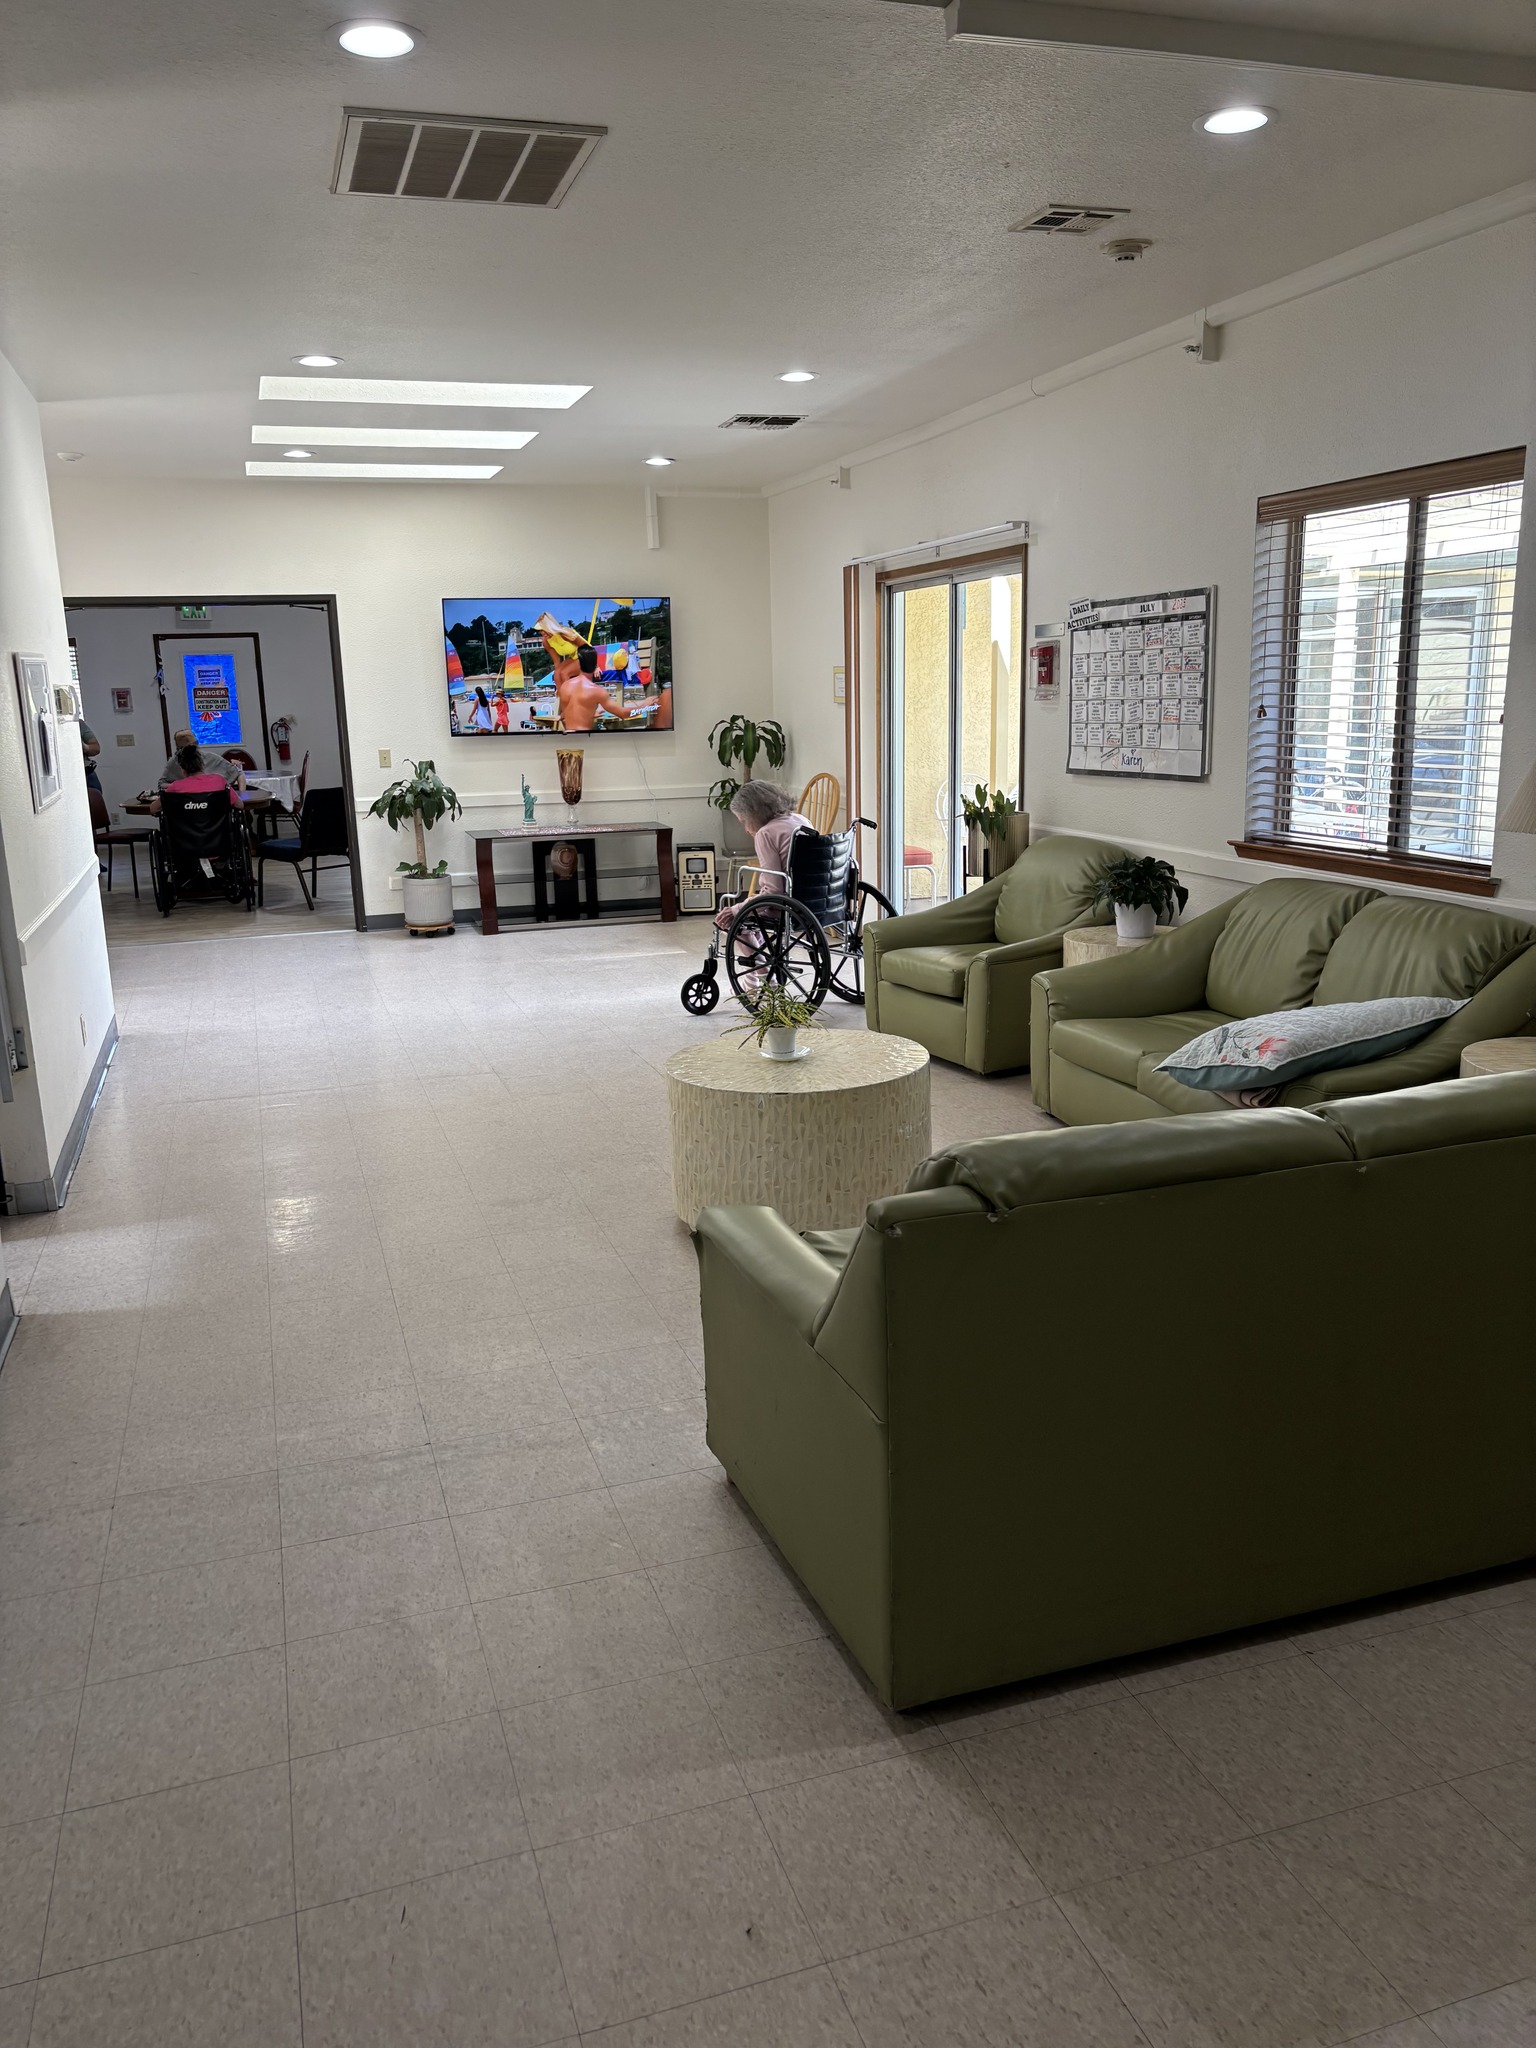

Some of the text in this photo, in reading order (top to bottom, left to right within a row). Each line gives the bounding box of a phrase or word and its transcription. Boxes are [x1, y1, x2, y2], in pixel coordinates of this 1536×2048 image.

[1072, 603, 1090, 615] DAILY
[1140, 603, 1155, 613] JULY
[1067, 613, 1099, 629] ACTIVITIES
[1121, 753, 1145, 773] Karen
[184, 801, 208, 810] drive
